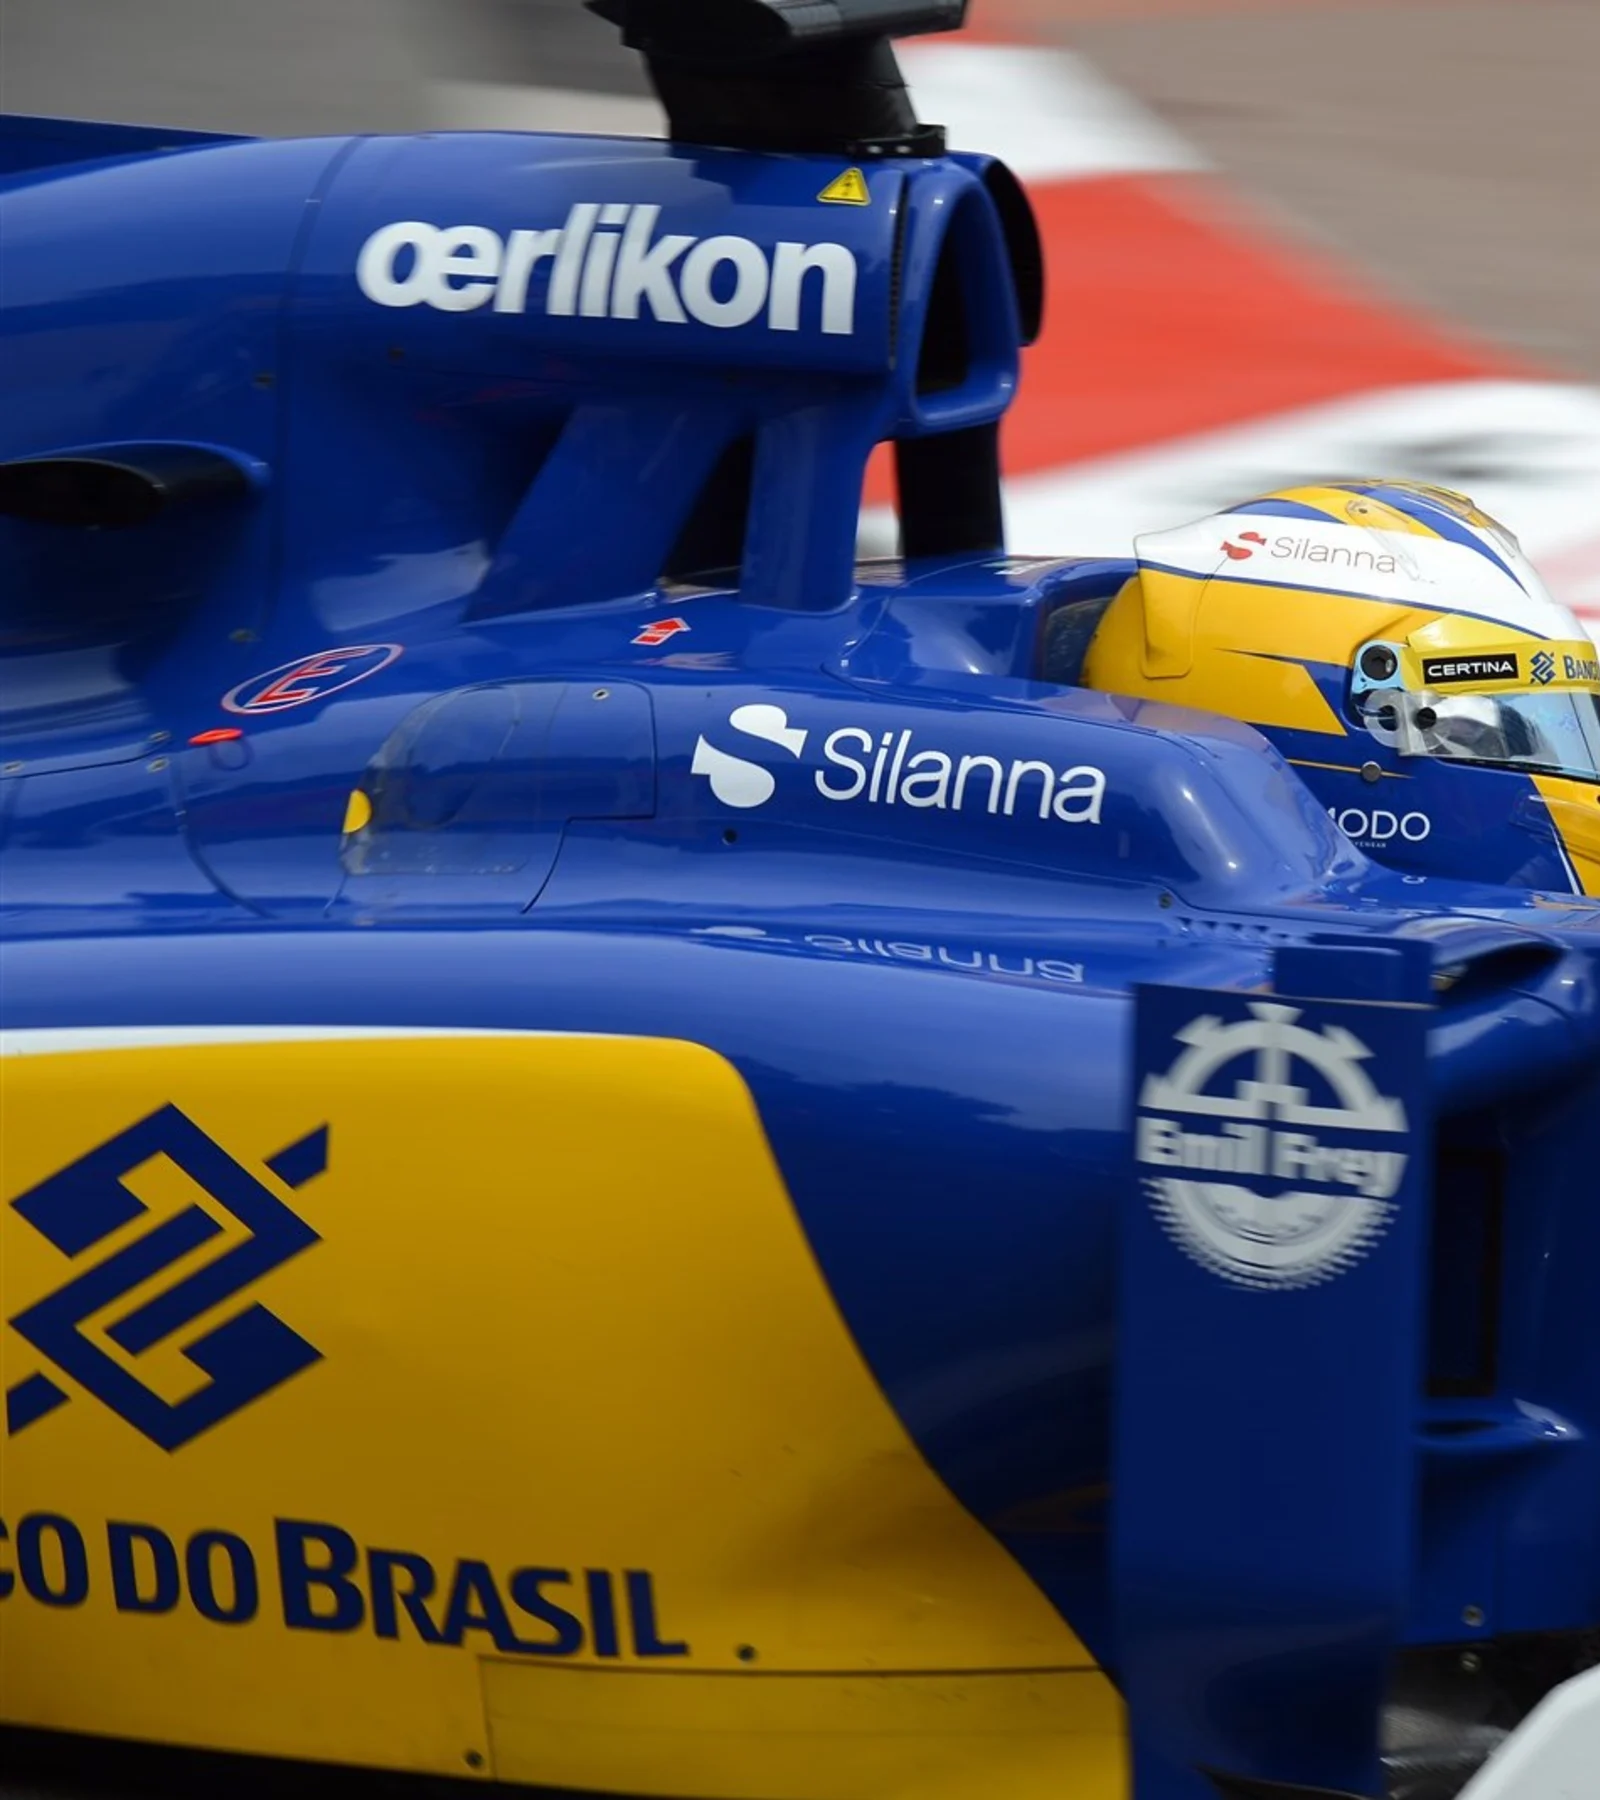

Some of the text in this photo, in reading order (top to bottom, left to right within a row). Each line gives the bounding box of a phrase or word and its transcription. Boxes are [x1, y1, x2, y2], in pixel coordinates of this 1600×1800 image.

[1270, 536, 1396, 573] Silanna
[1427, 660, 1515, 677] CERTINA
[814, 727, 1106, 824] Silanna
[1136, 1116, 1409, 1198] Emil Frey
[105, 1518, 259, 1626] DO
[273, 1516, 691, 1658] BRASIL
